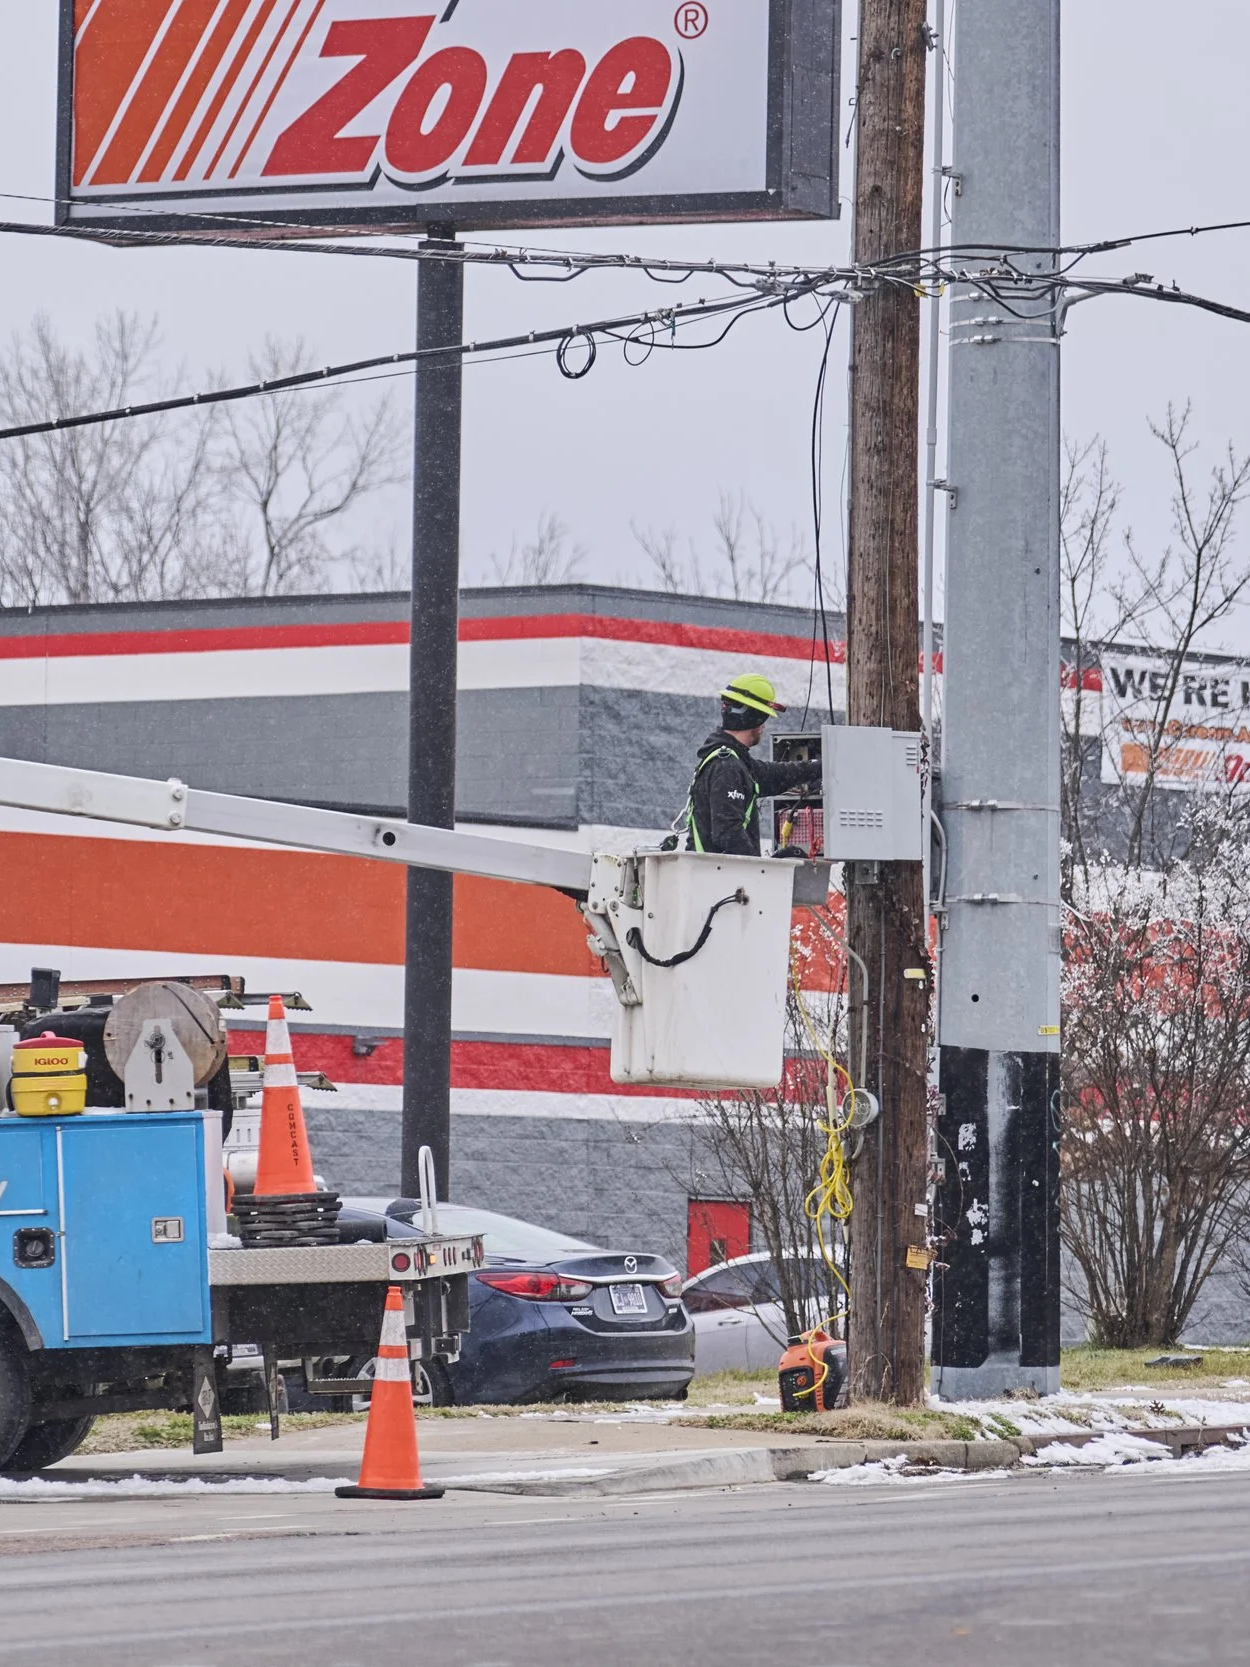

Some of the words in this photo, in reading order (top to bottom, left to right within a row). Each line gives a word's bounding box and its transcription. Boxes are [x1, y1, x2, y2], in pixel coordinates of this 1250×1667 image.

[260, 15, 672, 174] Zone
[34, 1057, 69, 1066] IGLOO
[287, 1103, 299, 1166] COMCAST
